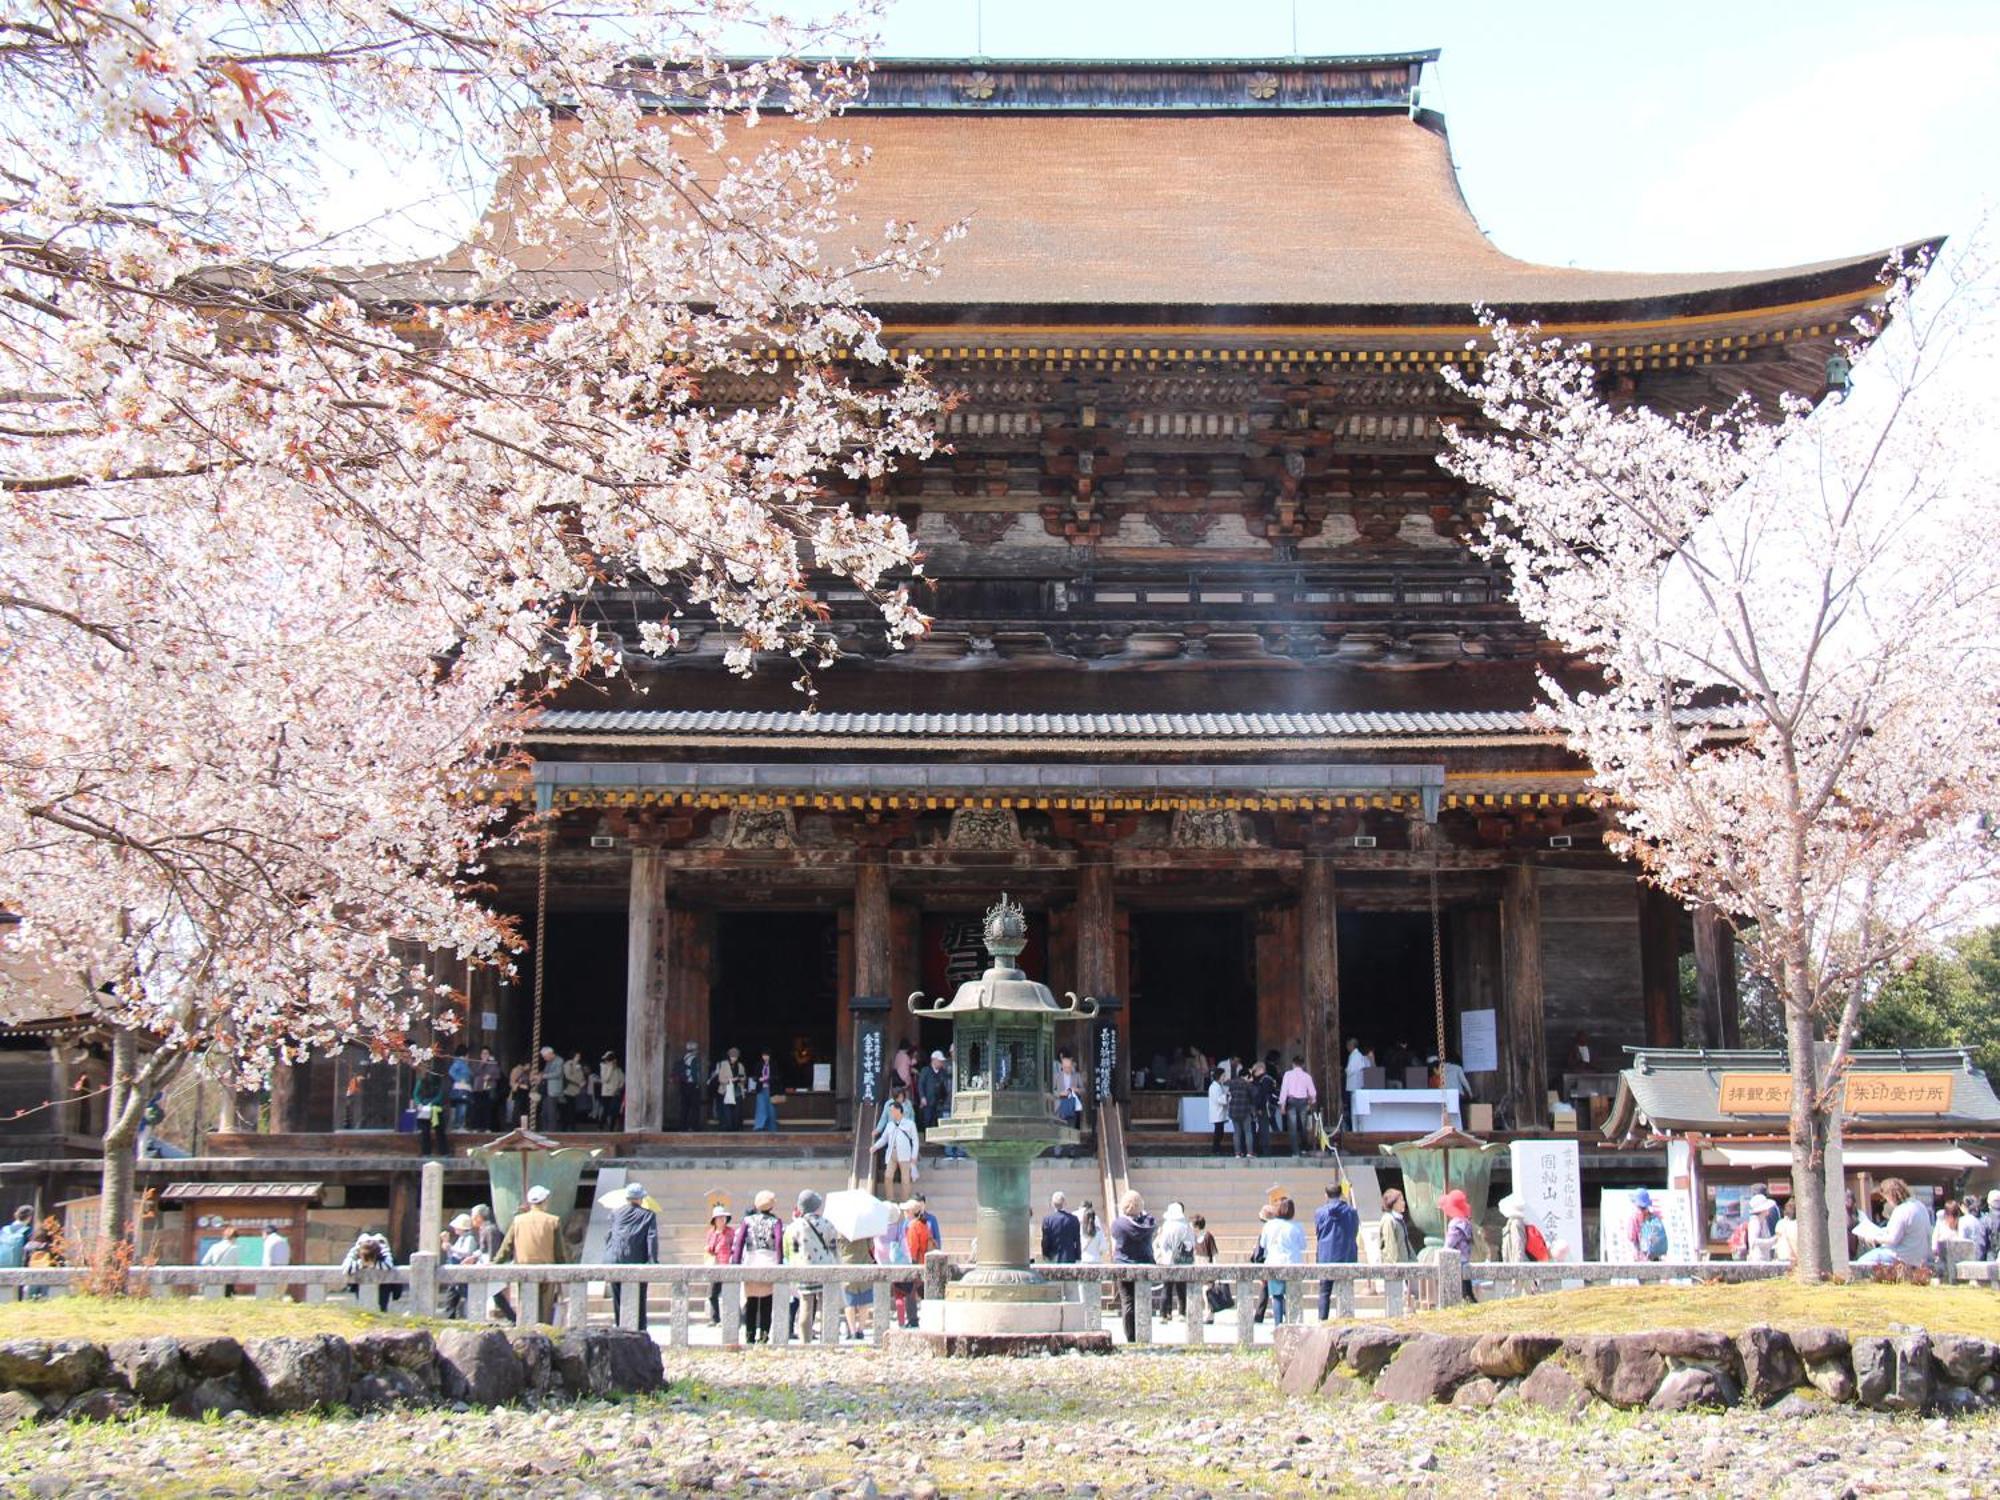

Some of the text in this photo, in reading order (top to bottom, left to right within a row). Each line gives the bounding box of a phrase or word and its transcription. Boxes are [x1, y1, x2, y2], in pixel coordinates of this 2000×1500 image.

[1853, 1086, 1945, 1102] 朱印受付所
